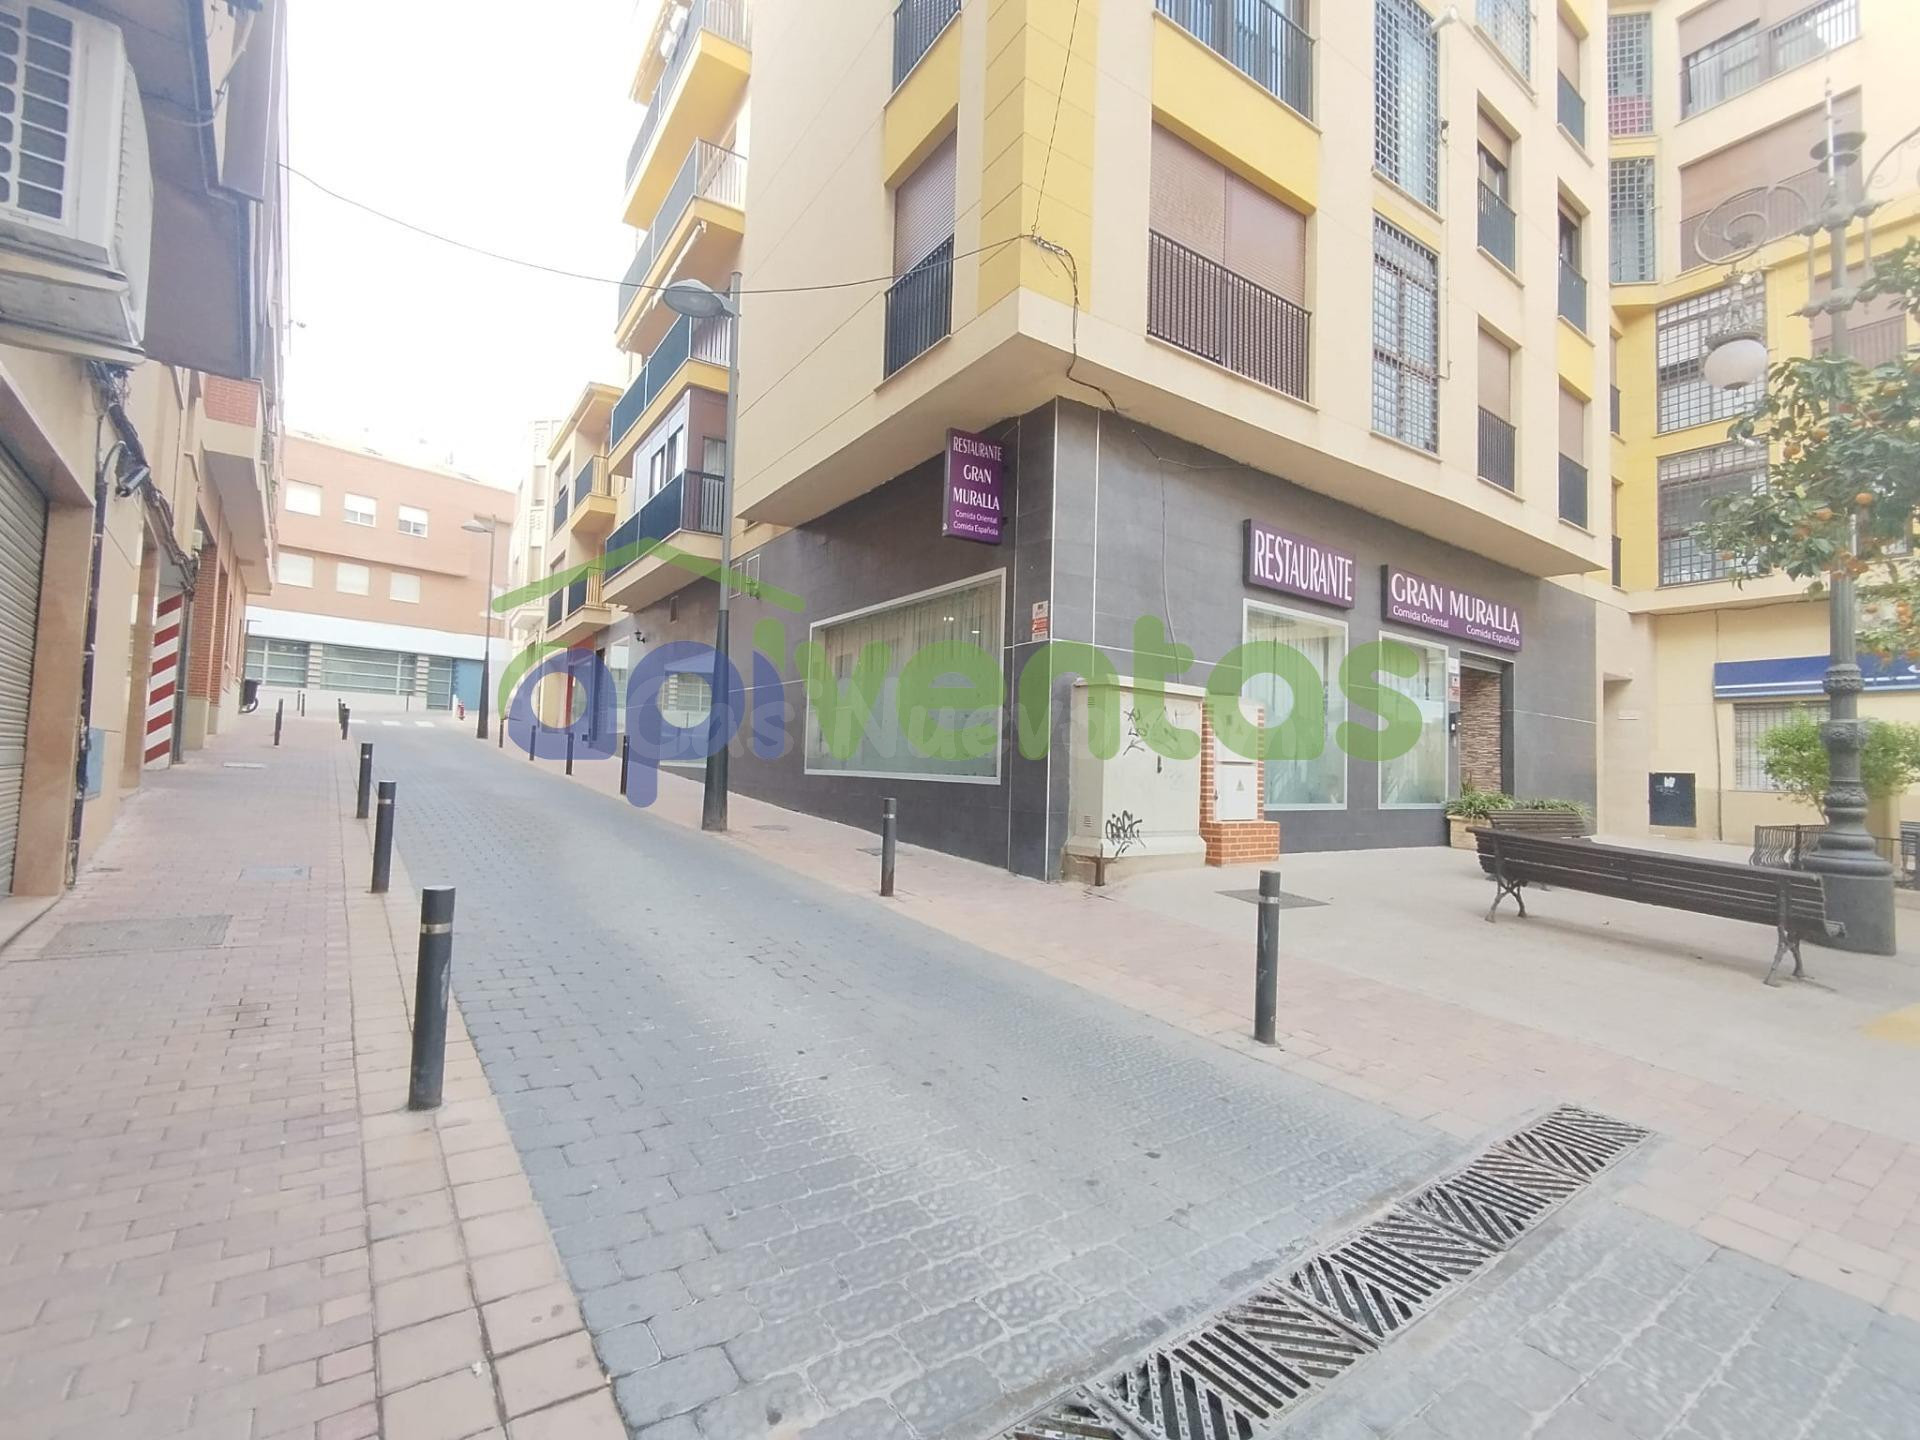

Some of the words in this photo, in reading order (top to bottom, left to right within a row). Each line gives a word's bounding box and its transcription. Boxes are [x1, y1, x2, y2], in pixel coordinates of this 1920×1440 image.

[953, 436, 1003, 461] RESTAURANTE
[963, 464, 992, 484] GRAN
[953, 487, 1000, 510] MURALLA
[953, 520, 974, 532] Comida
[974, 523, 999, 536] Española
[955, 509, 976, 521] Comida
[976, 513, 998, 524] Oriental
[1254, 529, 1353, 602] RESTAURANTE
[1391, 572, 1444, 613] GRAN
[1449, 590, 1520, 635] MURALLA
[1393, 605, 1421, 621] Comida
[1421, 612, 1449, 629] Oriental
[1466, 624, 1492, 641] Comida
[1492, 630, 1520, 647] Española
